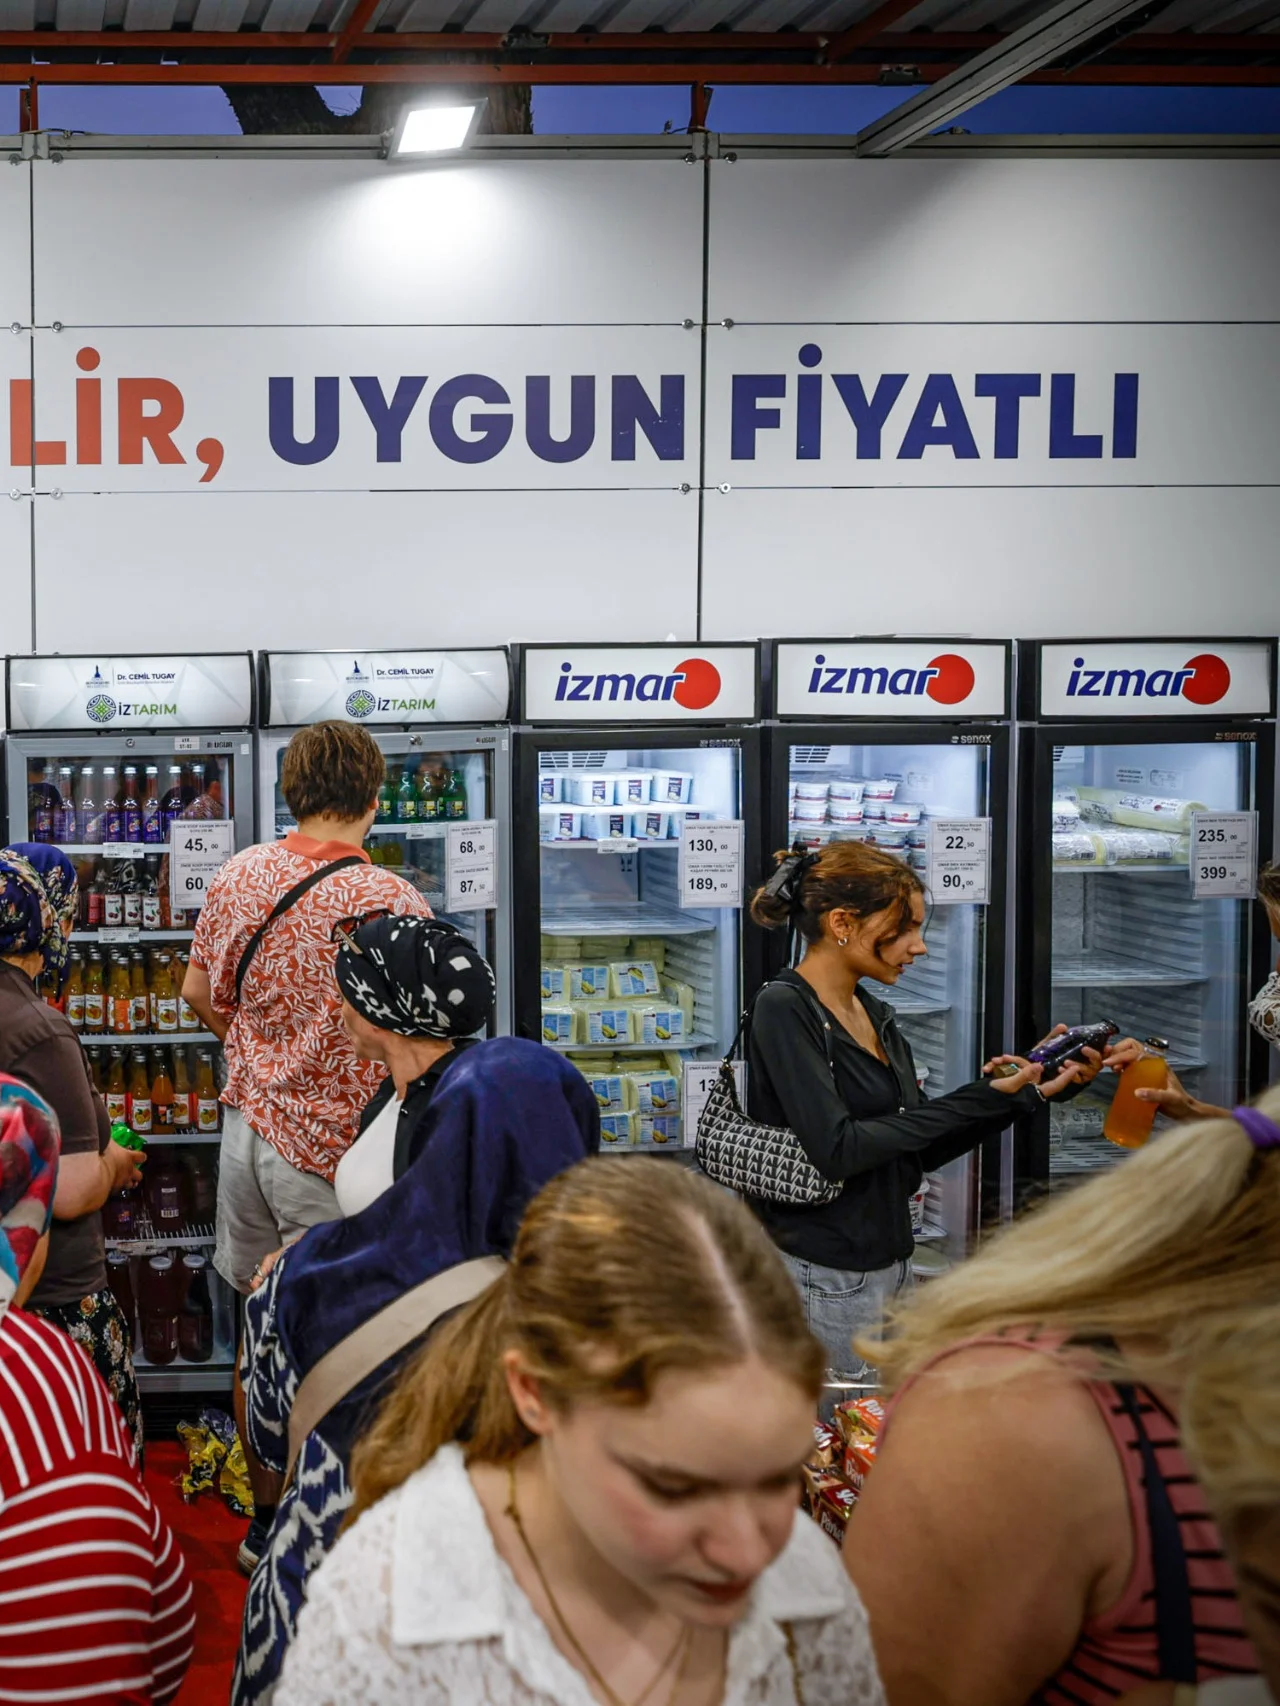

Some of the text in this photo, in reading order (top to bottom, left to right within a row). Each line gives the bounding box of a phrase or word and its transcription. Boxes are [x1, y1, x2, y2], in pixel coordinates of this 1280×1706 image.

[268, 373, 686, 465] UYGUN
[730, 343, 1140, 460] FİYATLI
[387, 667, 409, 675] CEMİL
[808, 654, 938, 696] izmar
[1066, 657, 1194, 697] izmar
[554, 662, 685, 702] izmar
[118, 702, 177, 716] İZTARIM
[377, 697, 436, 711] İZTARIM
[960, 734, 992, 744] senox
[1224, 732, 1257, 741] senox
